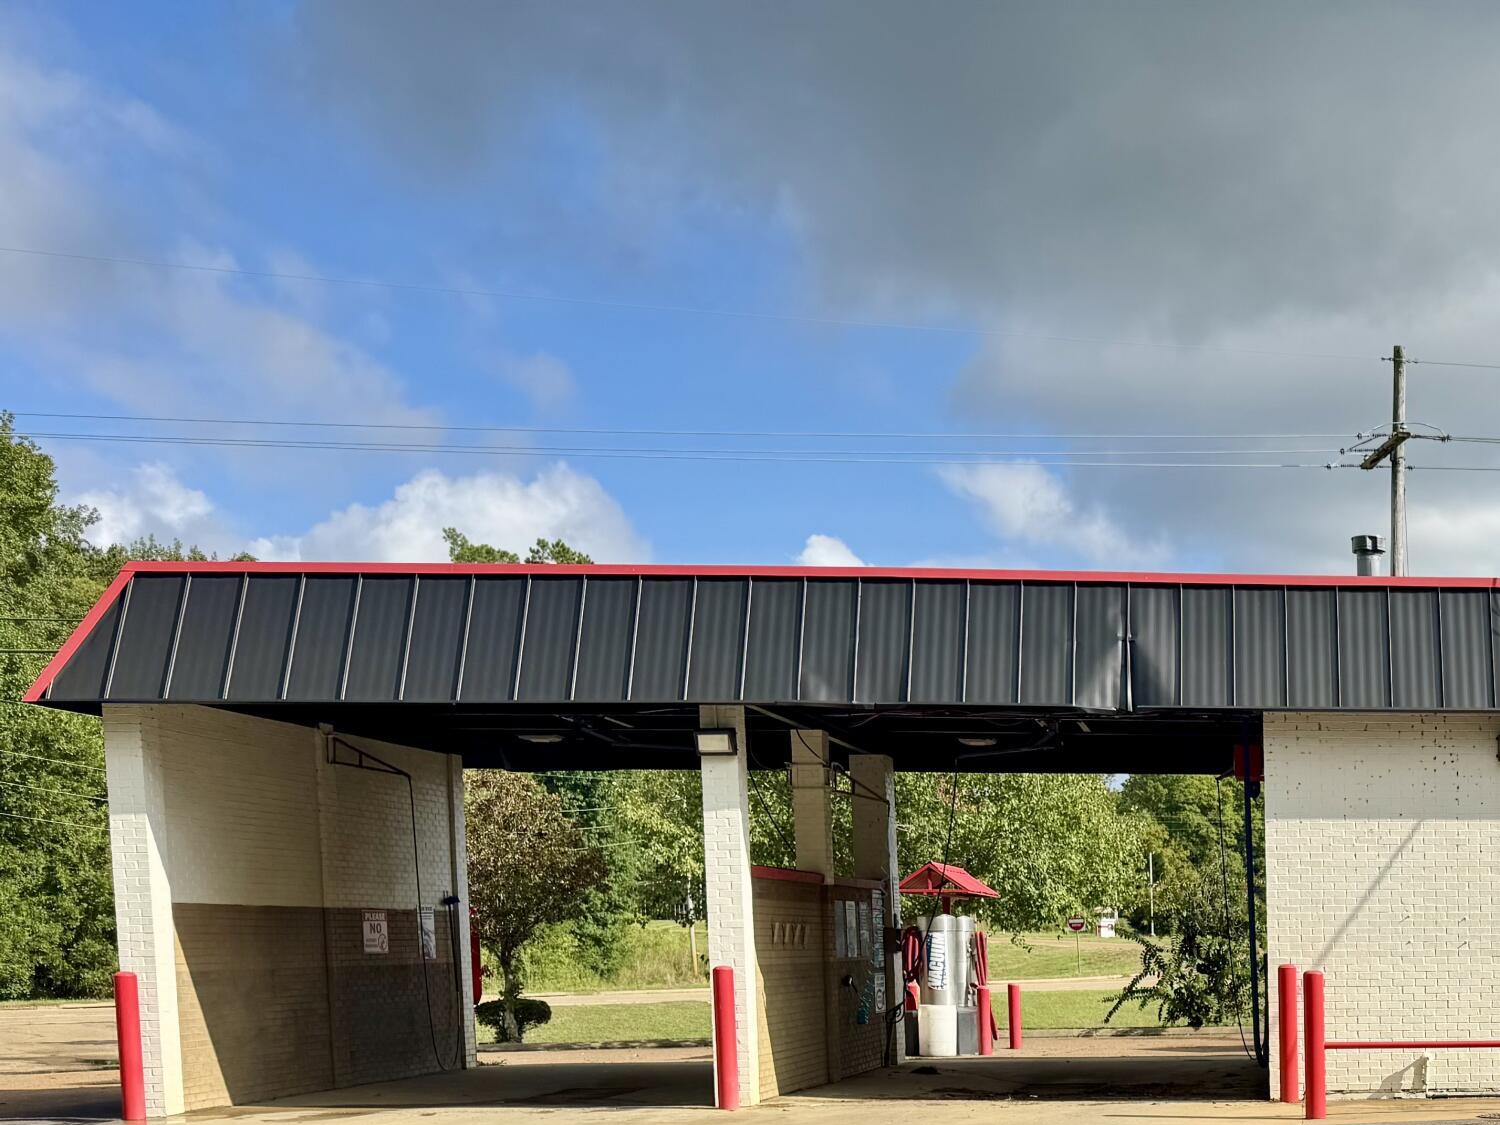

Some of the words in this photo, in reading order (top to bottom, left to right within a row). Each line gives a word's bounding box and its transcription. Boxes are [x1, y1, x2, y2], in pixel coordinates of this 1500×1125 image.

[364, 912, 386, 921] PLEASE
[369, 923, 383, 934] NO
[928, 933, 946, 989] VACUUM
